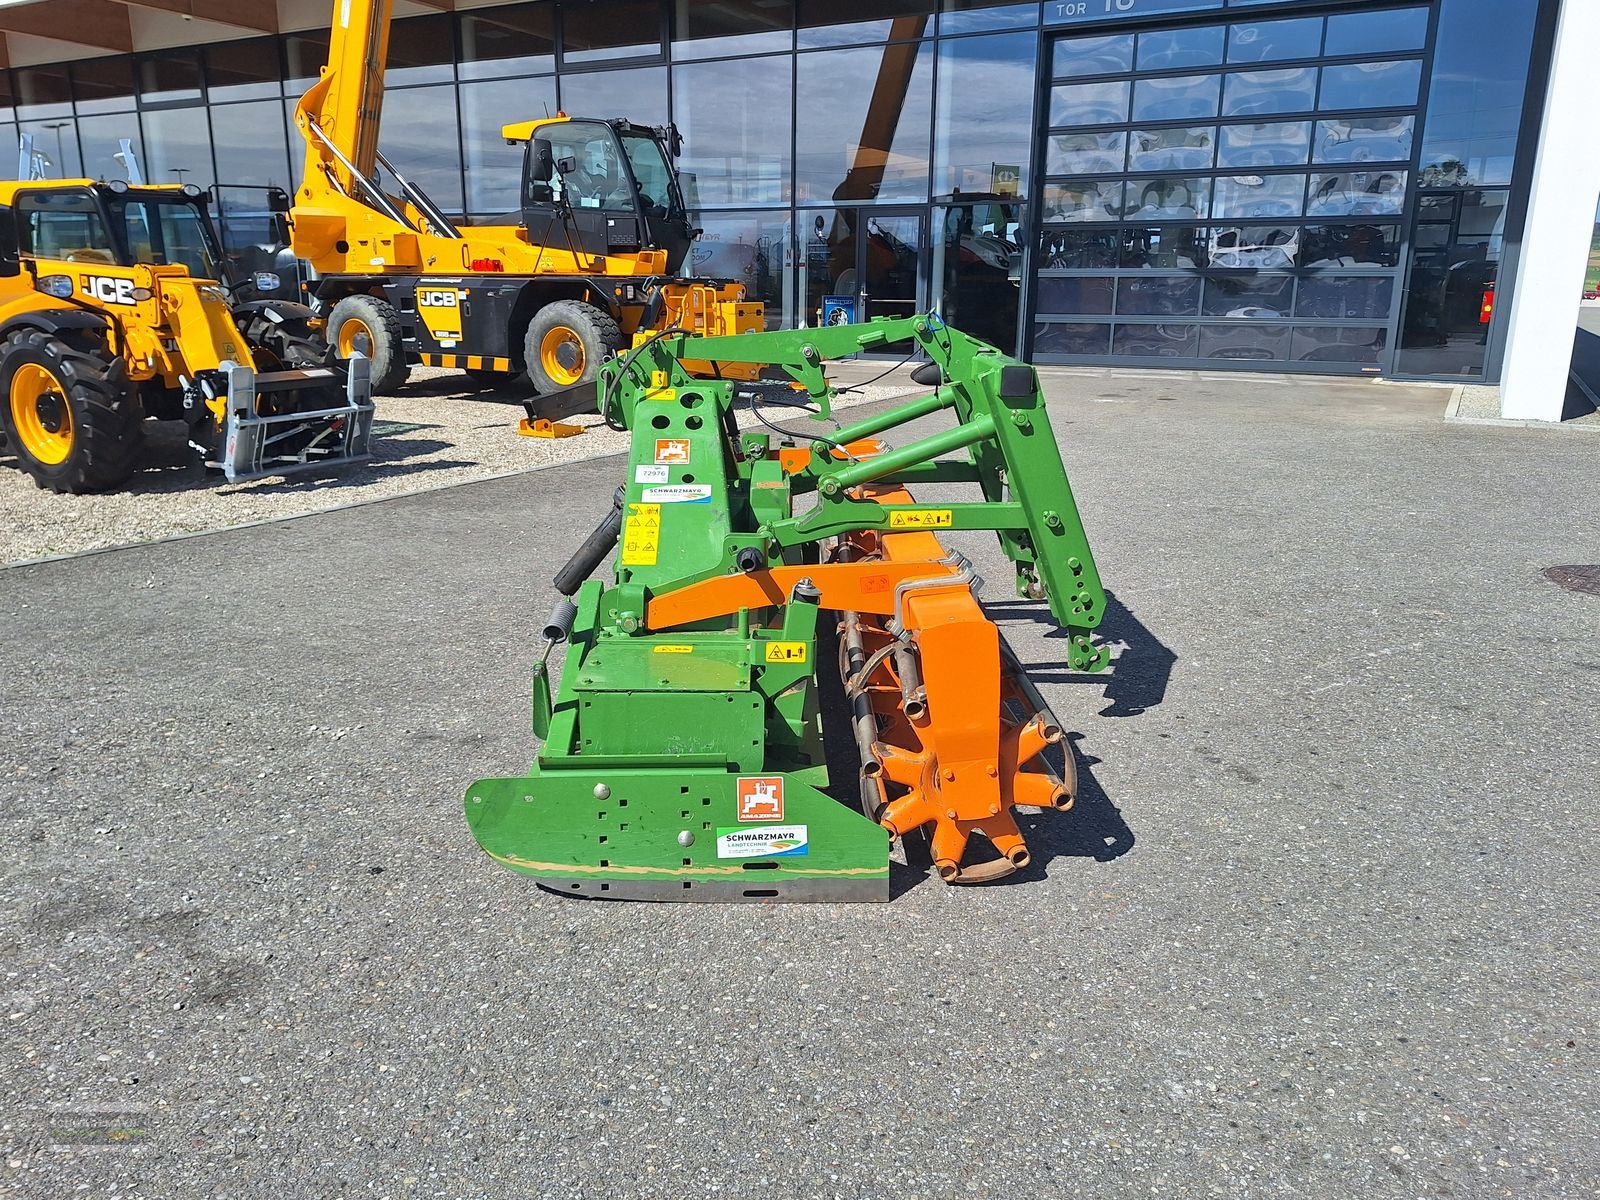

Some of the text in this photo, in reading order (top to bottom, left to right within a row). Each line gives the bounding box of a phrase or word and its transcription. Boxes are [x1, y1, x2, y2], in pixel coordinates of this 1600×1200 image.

[1056, 2, 1087, 17] TOR
[82, 276, 137, 305] JCB
[421, 291, 456, 307] JCB
[726, 832, 795, 842] SCHWARZMAYR
